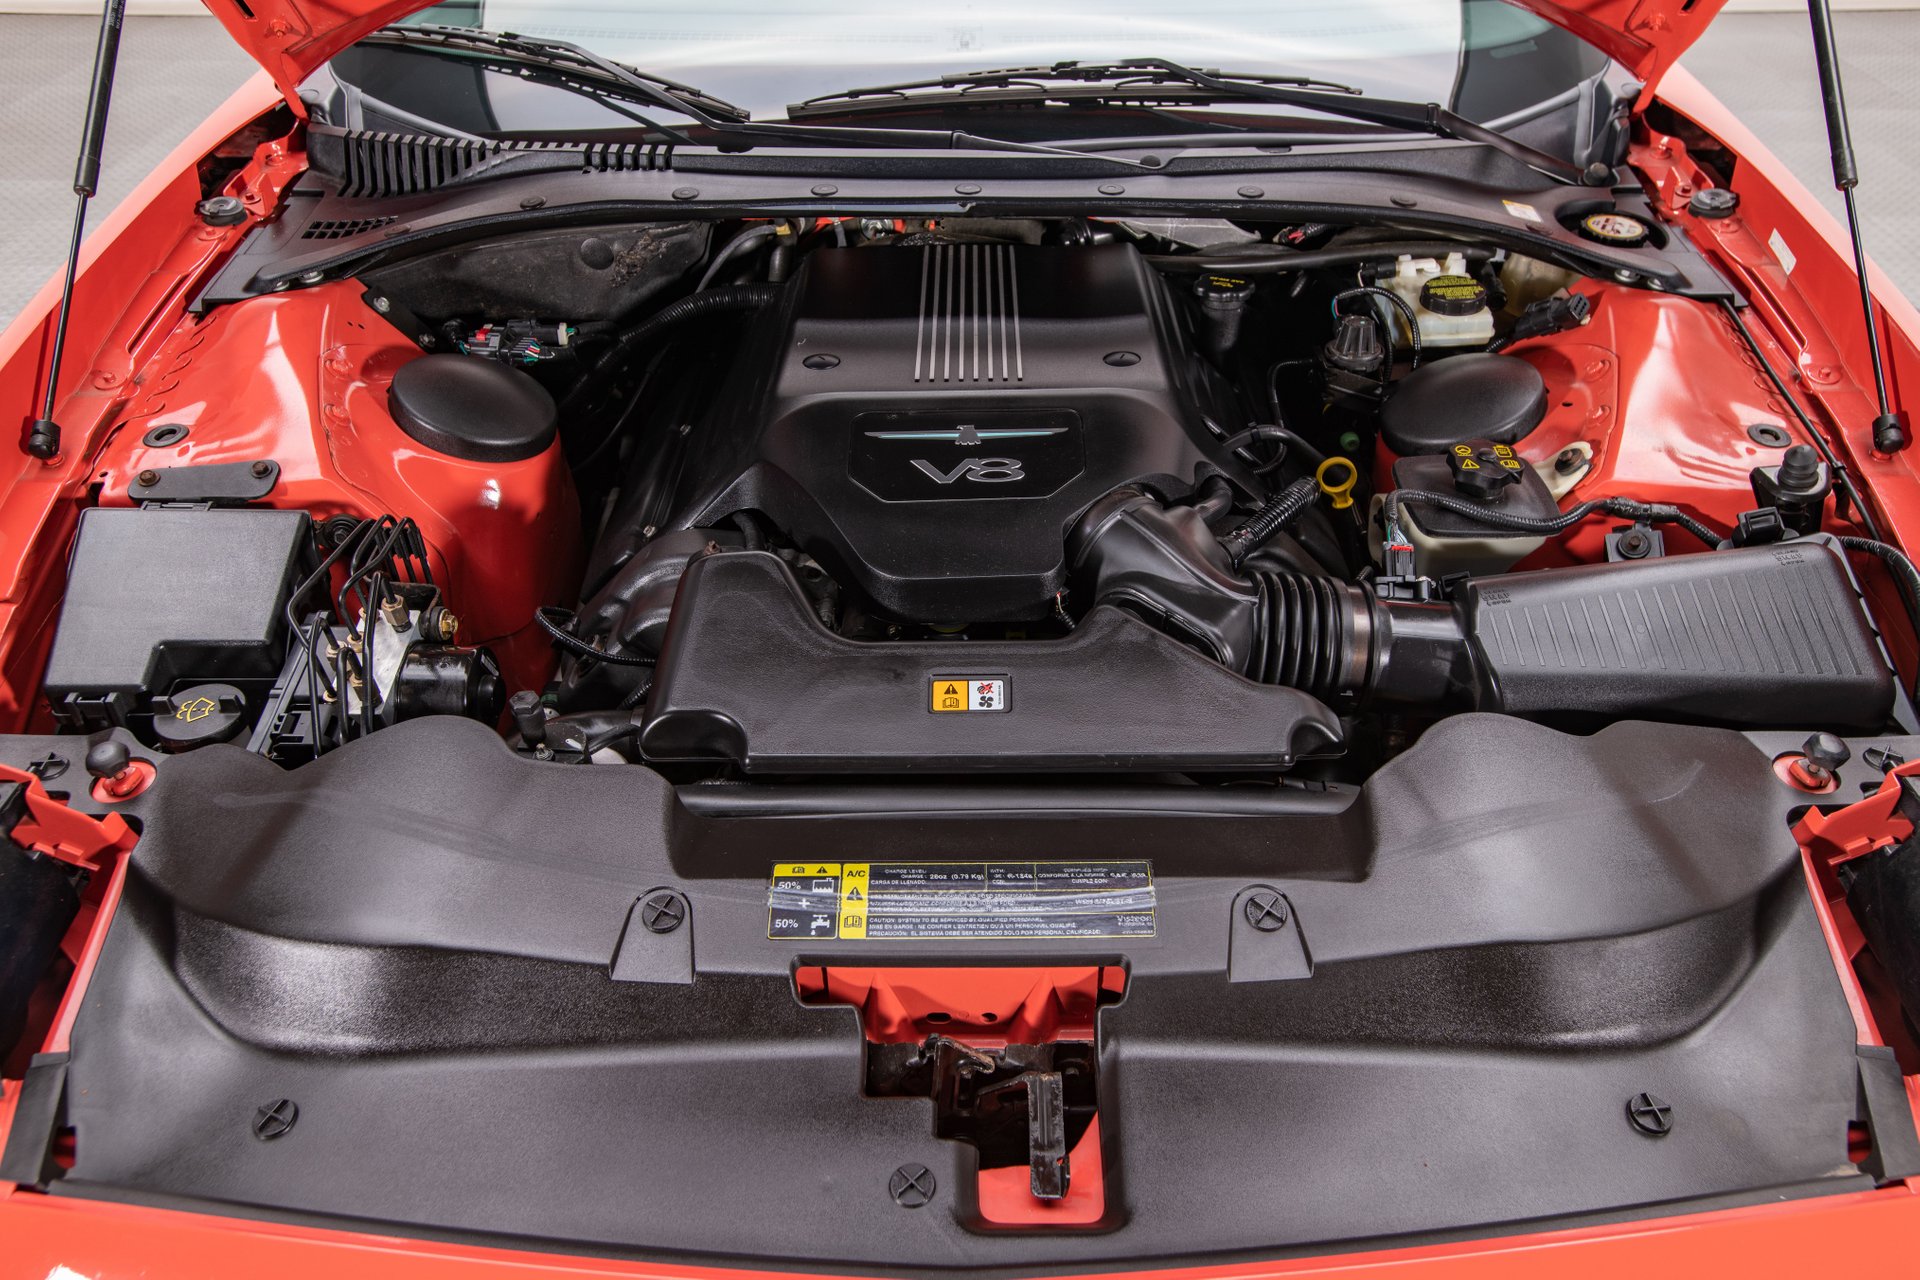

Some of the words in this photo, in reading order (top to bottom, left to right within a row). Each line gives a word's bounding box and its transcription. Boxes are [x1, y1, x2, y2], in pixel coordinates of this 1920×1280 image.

[910, 457, 1025, 484] V8
[846, 869, 866, 878] A/C
[777, 881, 801, 890] 50%
[774, 919, 799, 928] 50%
